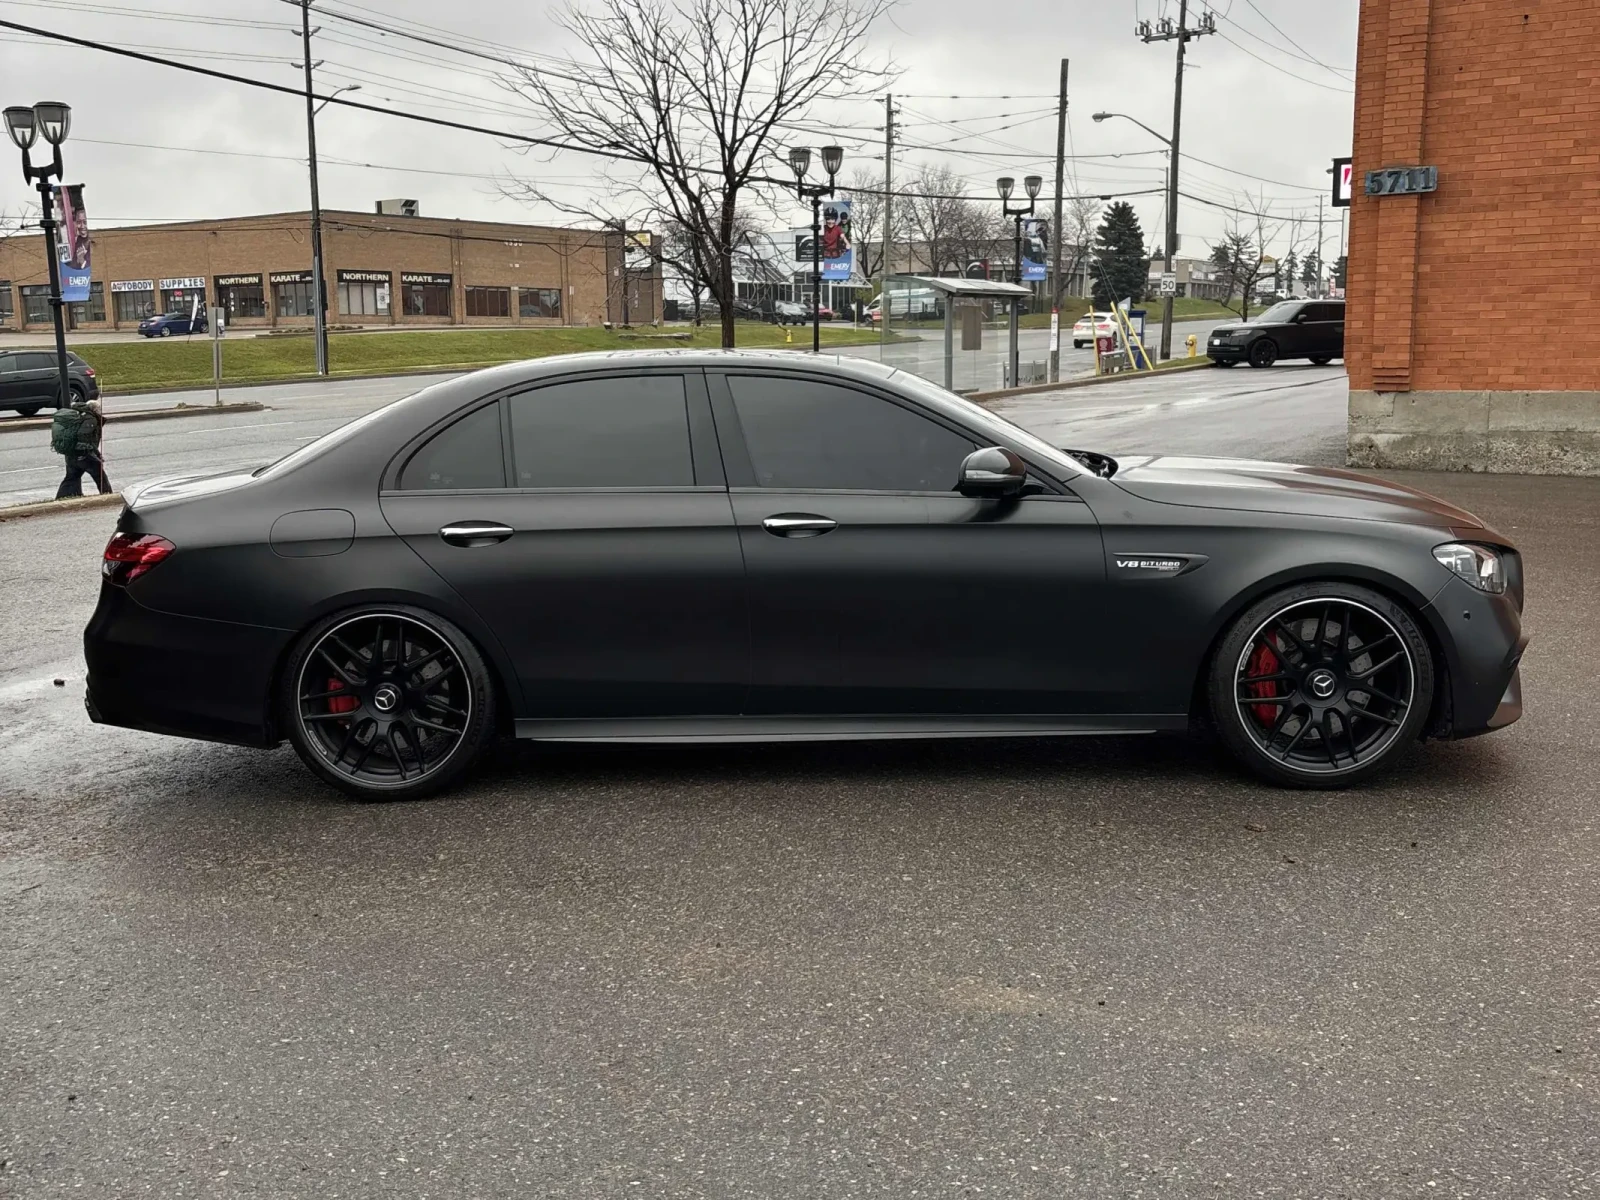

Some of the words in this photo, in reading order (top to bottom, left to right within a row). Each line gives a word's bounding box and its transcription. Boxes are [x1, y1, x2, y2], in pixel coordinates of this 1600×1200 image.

[1370, 168, 1433, 194] 5711
[69, 276, 91, 287] EMERY
[219, 276, 259, 285] NORTHERN
[270, 274, 300, 283] KARATE
[342, 273, 389, 281] NORTHERN
[402, 275, 433, 283] KARATE
[112, 281, 152, 290] AUTOBODY
[160, 278, 205, 288] SUPPLIES
[1162, 280, 1175, 290] 50
[1116, 560, 1139, 568] V8
